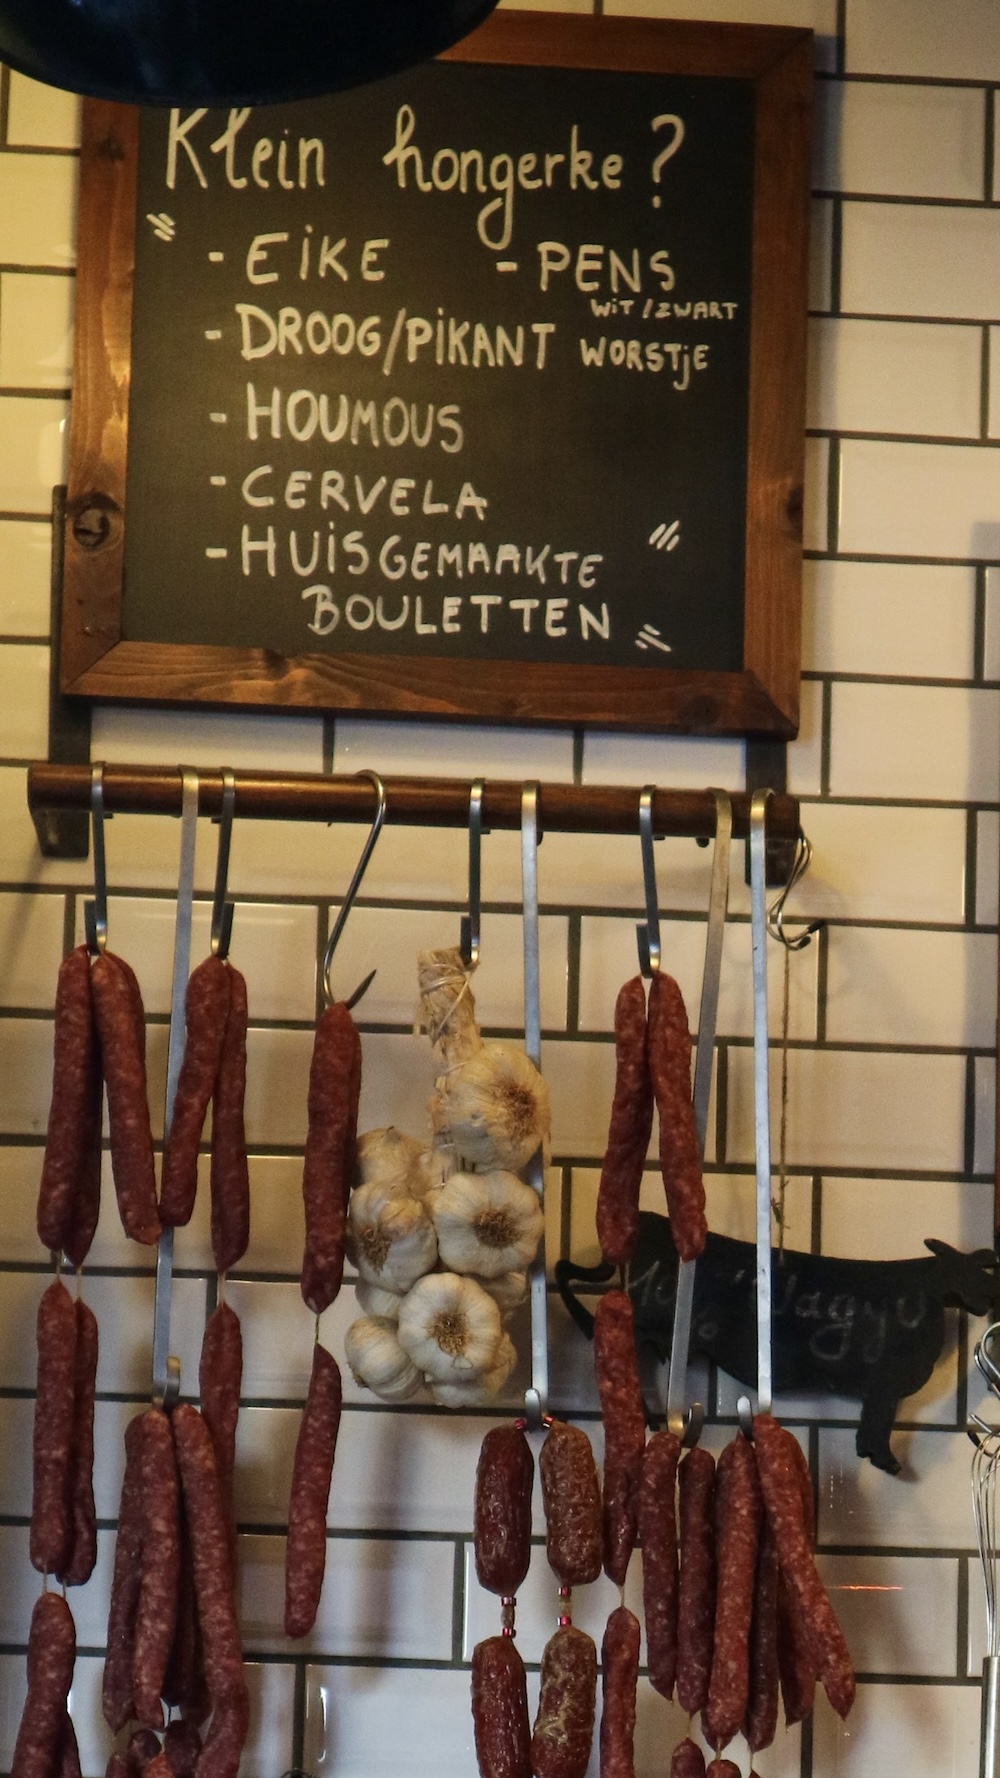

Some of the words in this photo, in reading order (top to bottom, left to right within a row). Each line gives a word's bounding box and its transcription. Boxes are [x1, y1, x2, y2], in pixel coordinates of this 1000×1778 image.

[167, 108, 324, 189] Klein
[382, 105, 621, 251] hongerke
[538, 242, 673, 293] PENS
[246, 382, 462, 453] HOUMOUS
[241, 465, 487, 520] CERVELA
[302, 584, 609, 640] BOULETTEN
